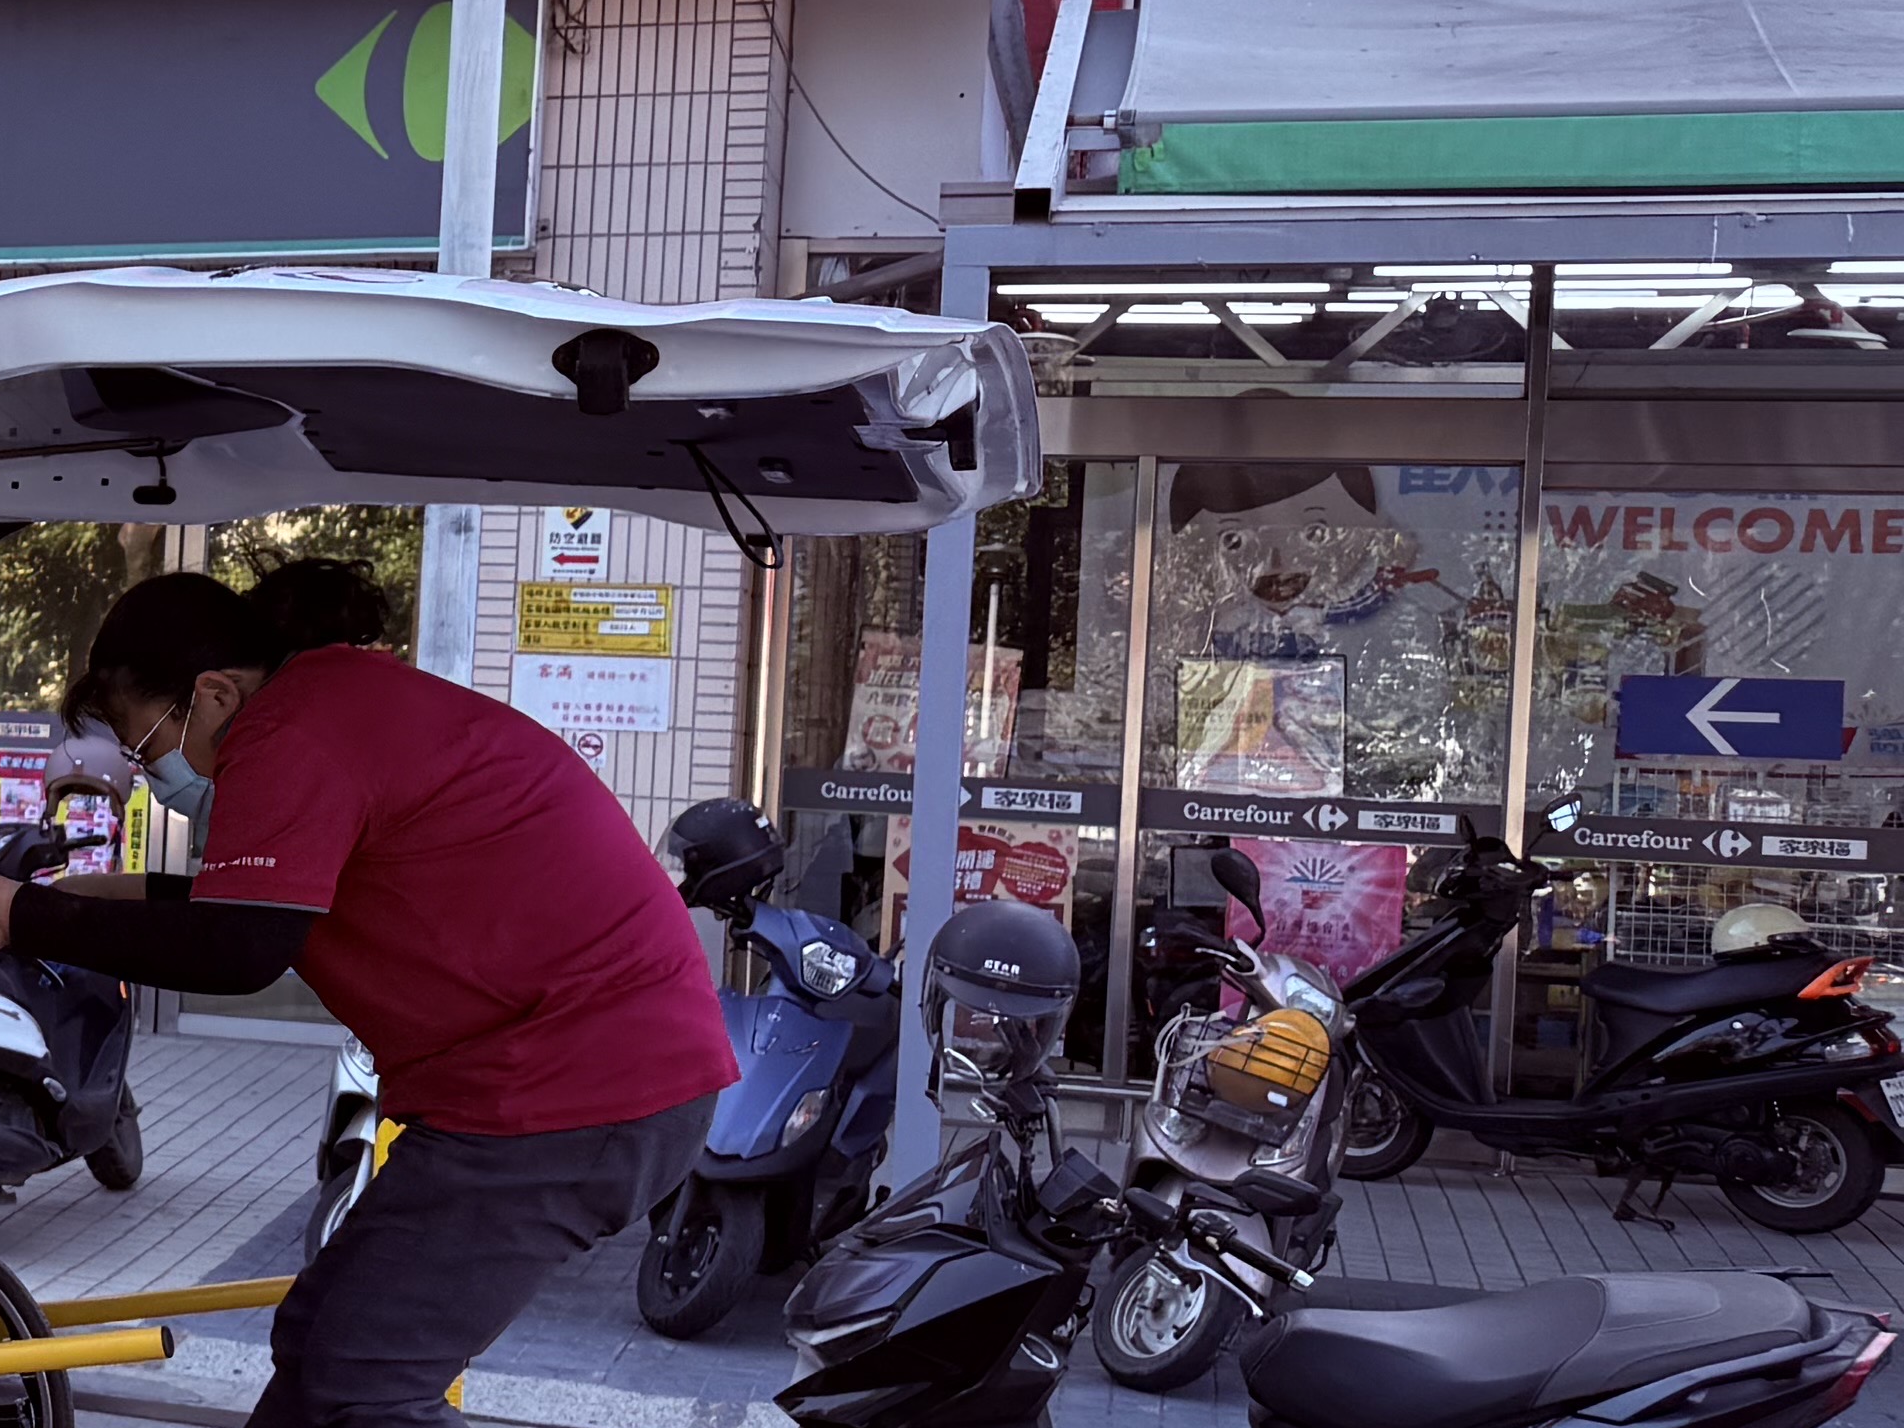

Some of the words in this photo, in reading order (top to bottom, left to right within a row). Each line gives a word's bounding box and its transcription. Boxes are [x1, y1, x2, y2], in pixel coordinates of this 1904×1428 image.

[1545, 505, 1904, 554] WELCOME
[821, 781, 913, 802] Carrefou
[1183, 802, 1294, 825] Carrefour
[1573, 828, 1693, 852] Carrefour
